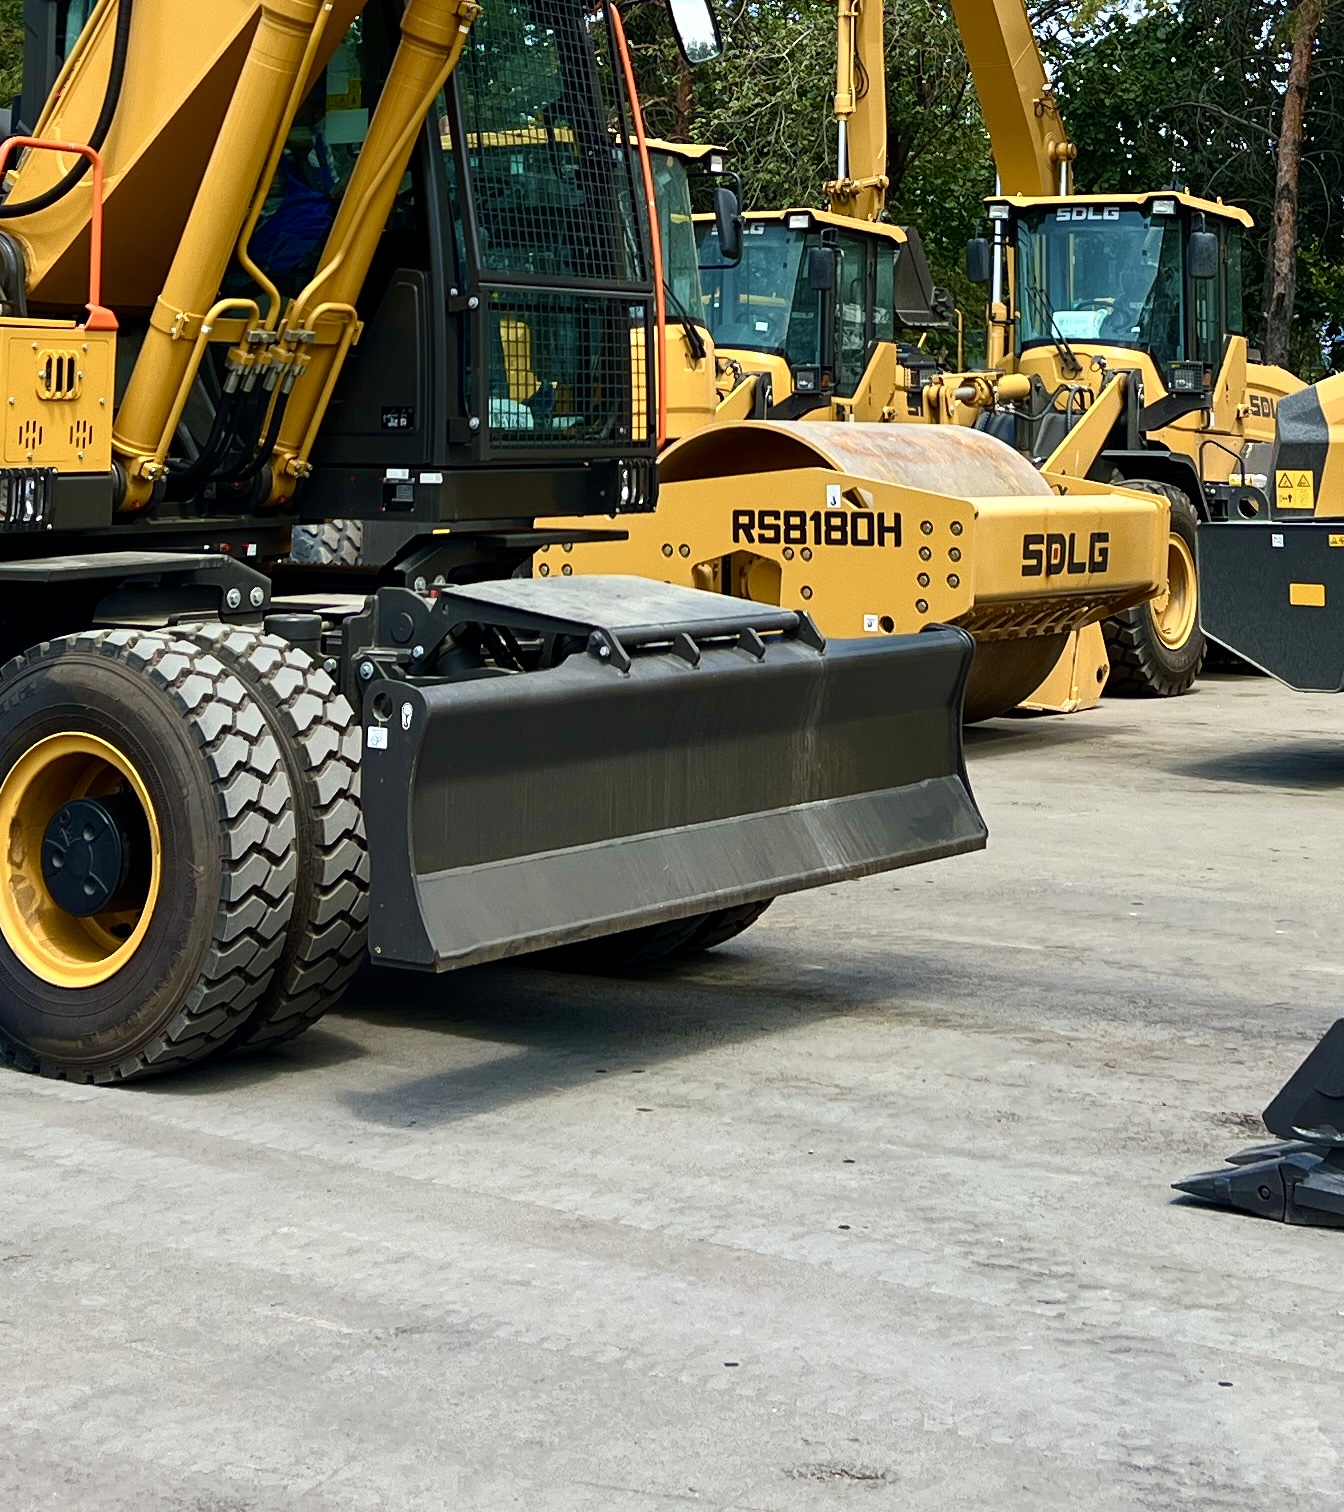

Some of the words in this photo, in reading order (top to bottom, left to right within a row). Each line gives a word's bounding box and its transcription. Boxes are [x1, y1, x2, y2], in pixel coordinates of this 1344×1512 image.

[1056, 207, 1120, 222] SDLG
[732, 509, 902, 548] RS8180H
[1021, 532, 1110, 577] SDLG
